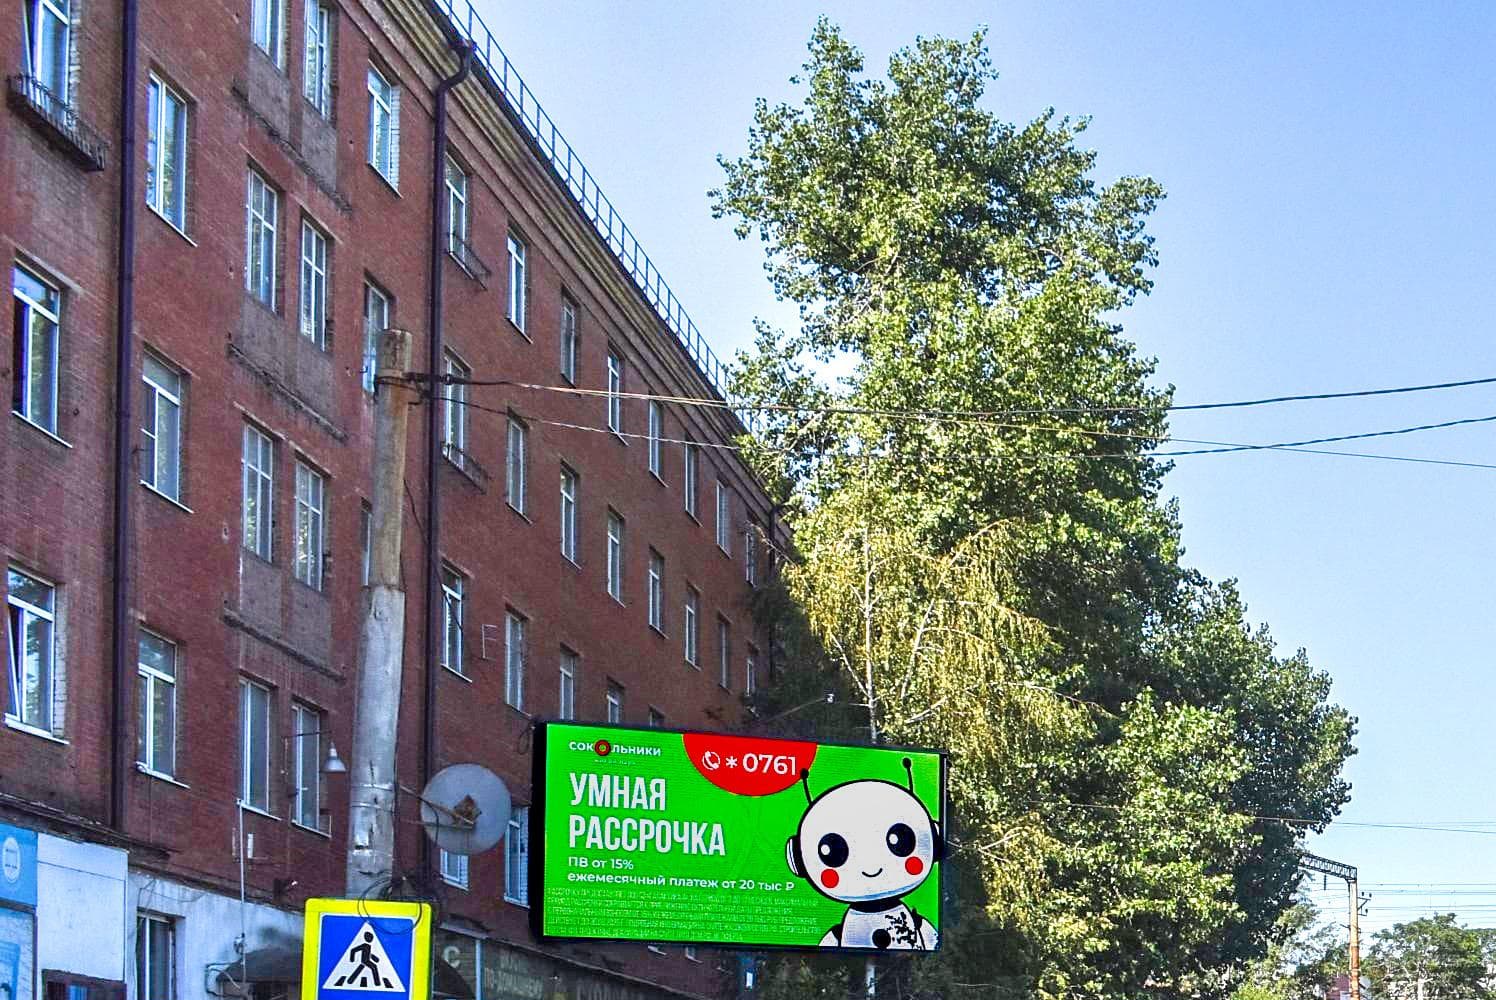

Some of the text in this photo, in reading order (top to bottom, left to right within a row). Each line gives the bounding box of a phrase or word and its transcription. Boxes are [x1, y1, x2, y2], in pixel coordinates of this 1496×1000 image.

[569, 772, 666, 811] УМНАЯ
[568, 814, 726, 856] РАССРОЧКА
[568, 857, 634, 870] ПВ от 15%
[567, 872, 666, 886] ежемесячный
[670, 877, 718, 889] платеж
[722, 880, 736, 889] от
[739, 880, 755, 890] 20
[759, 881, 782, 891] тыс
